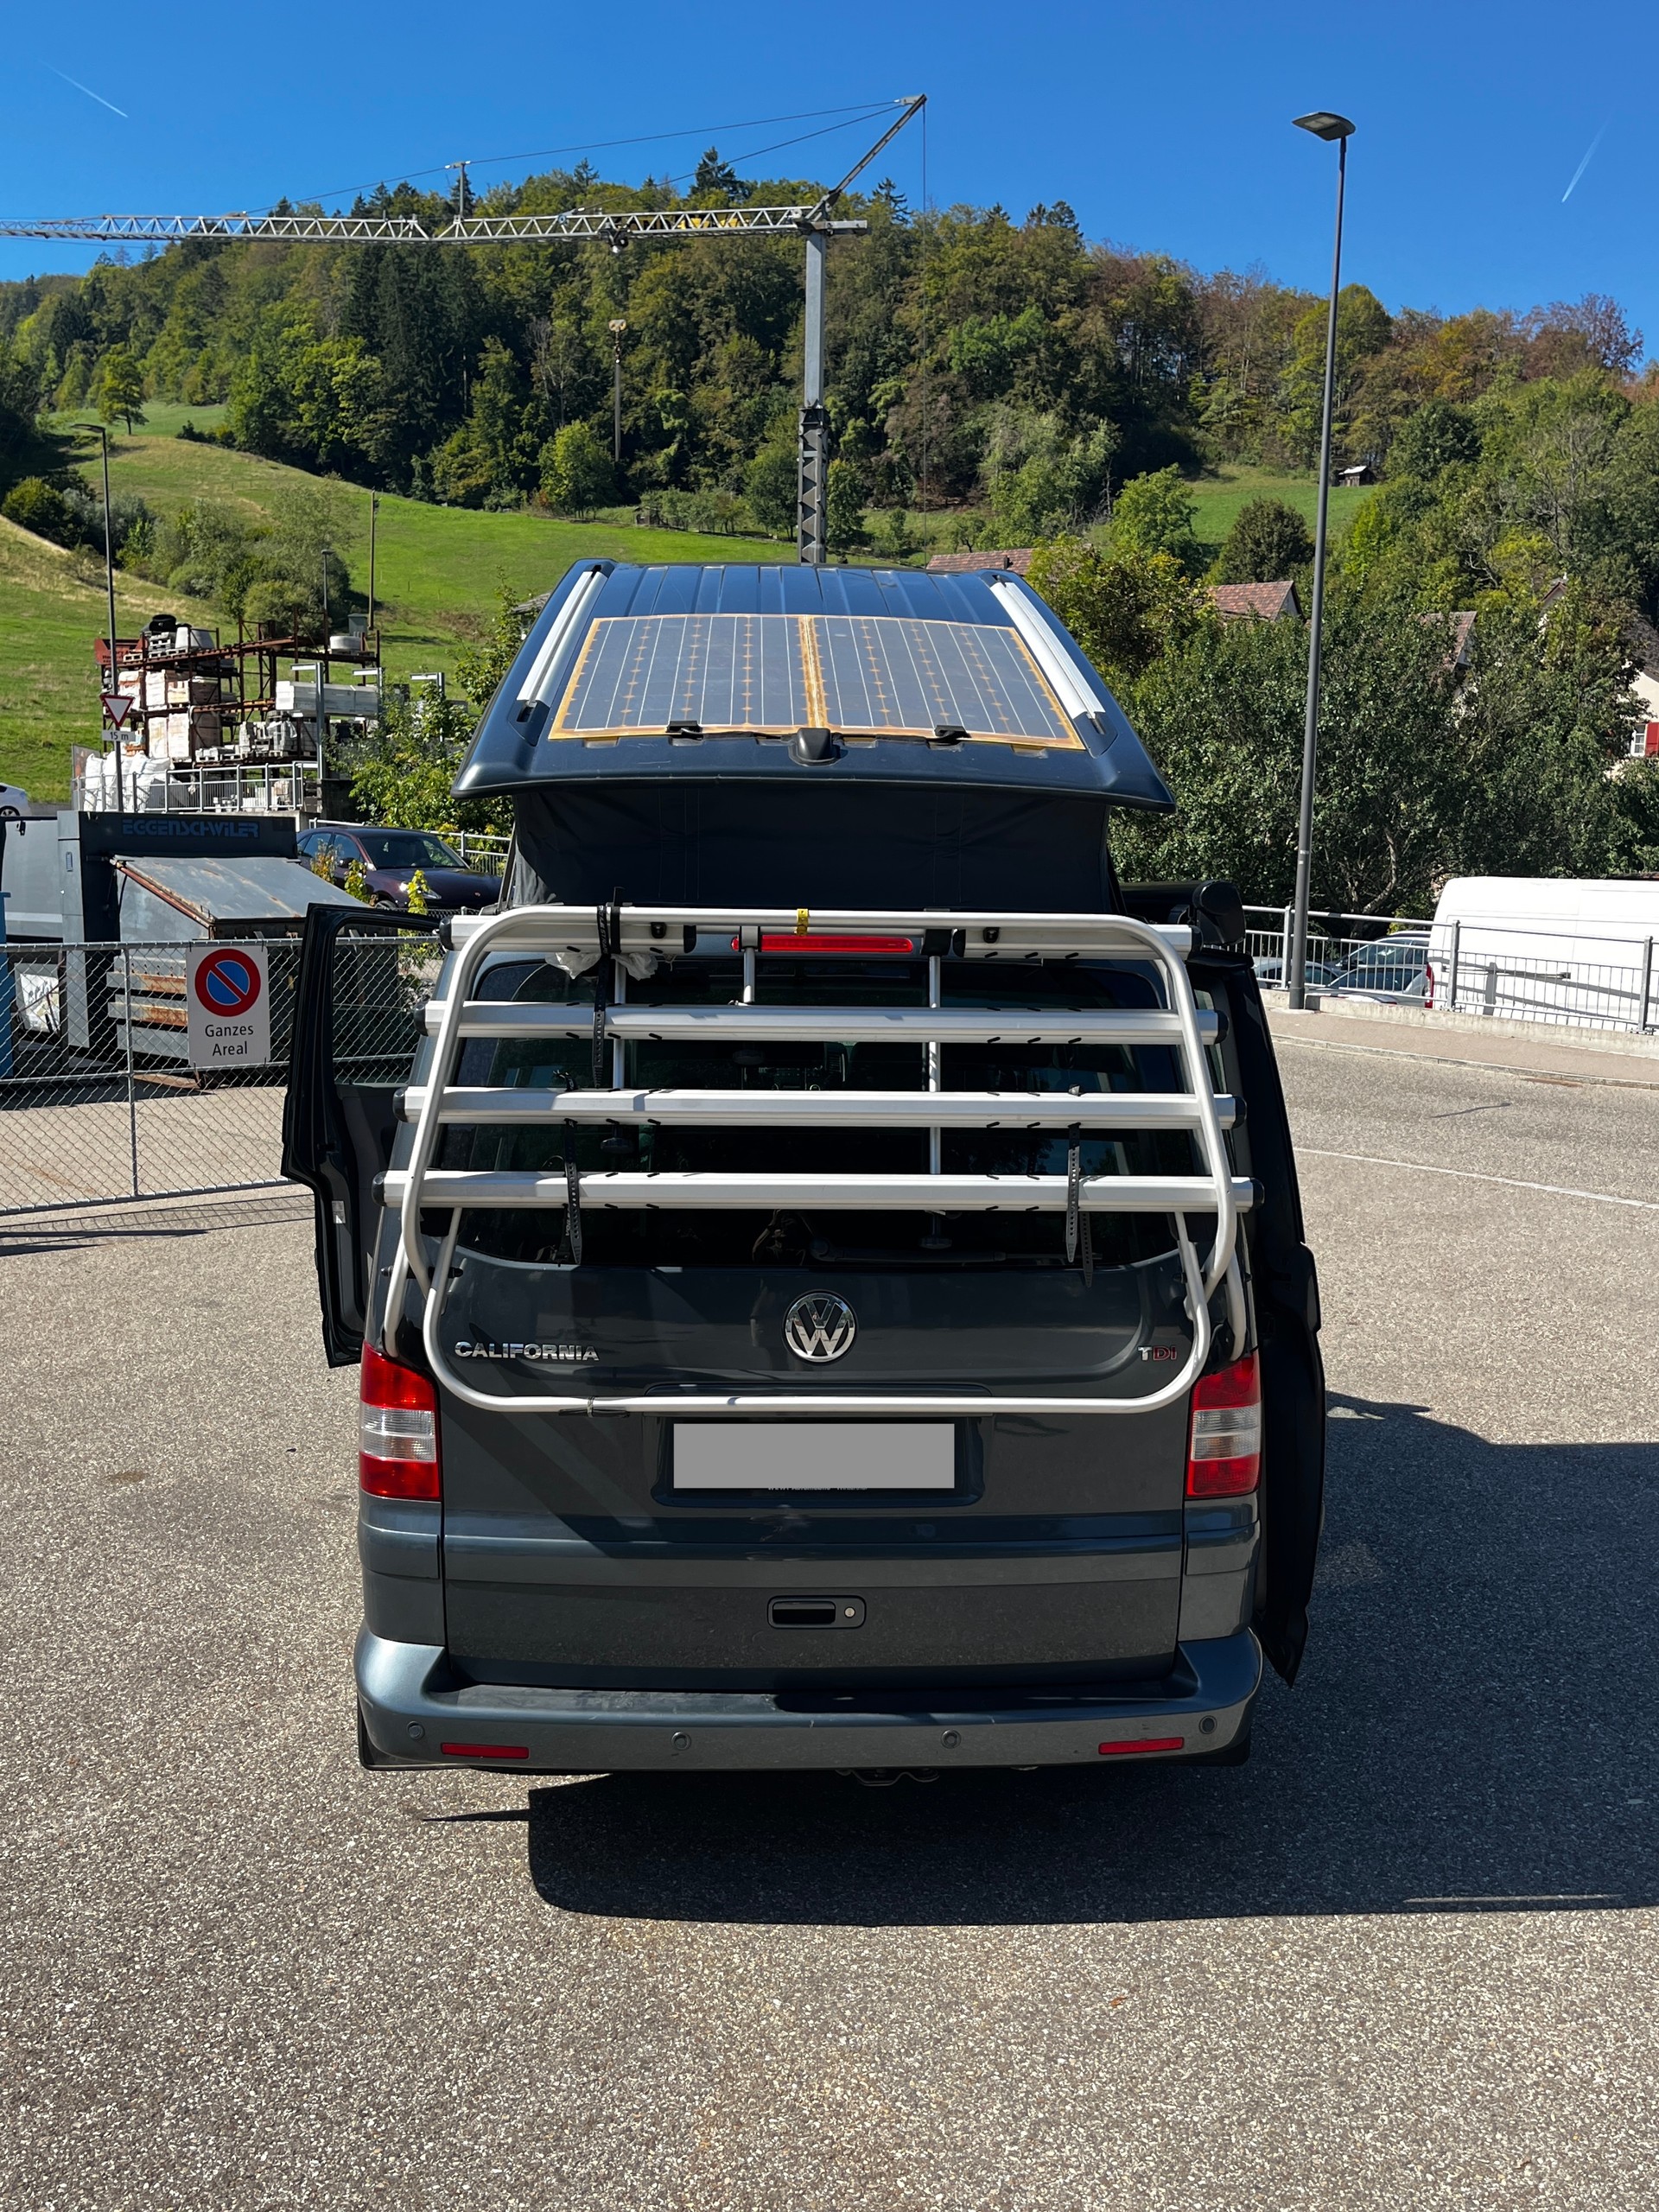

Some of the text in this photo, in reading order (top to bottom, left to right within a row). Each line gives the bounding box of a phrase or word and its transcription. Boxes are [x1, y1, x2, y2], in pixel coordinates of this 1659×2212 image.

[110, 731, 118, 741] 15
[205, 1024, 254, 1038] Ganzes
[212, 1040, 248, 1057] Areal
[785, 1293, 855, 1363] VW
[454, 1341, 600, 1361] CALIFORNIA
[1137, 1345, 1177, 1361] TDI
